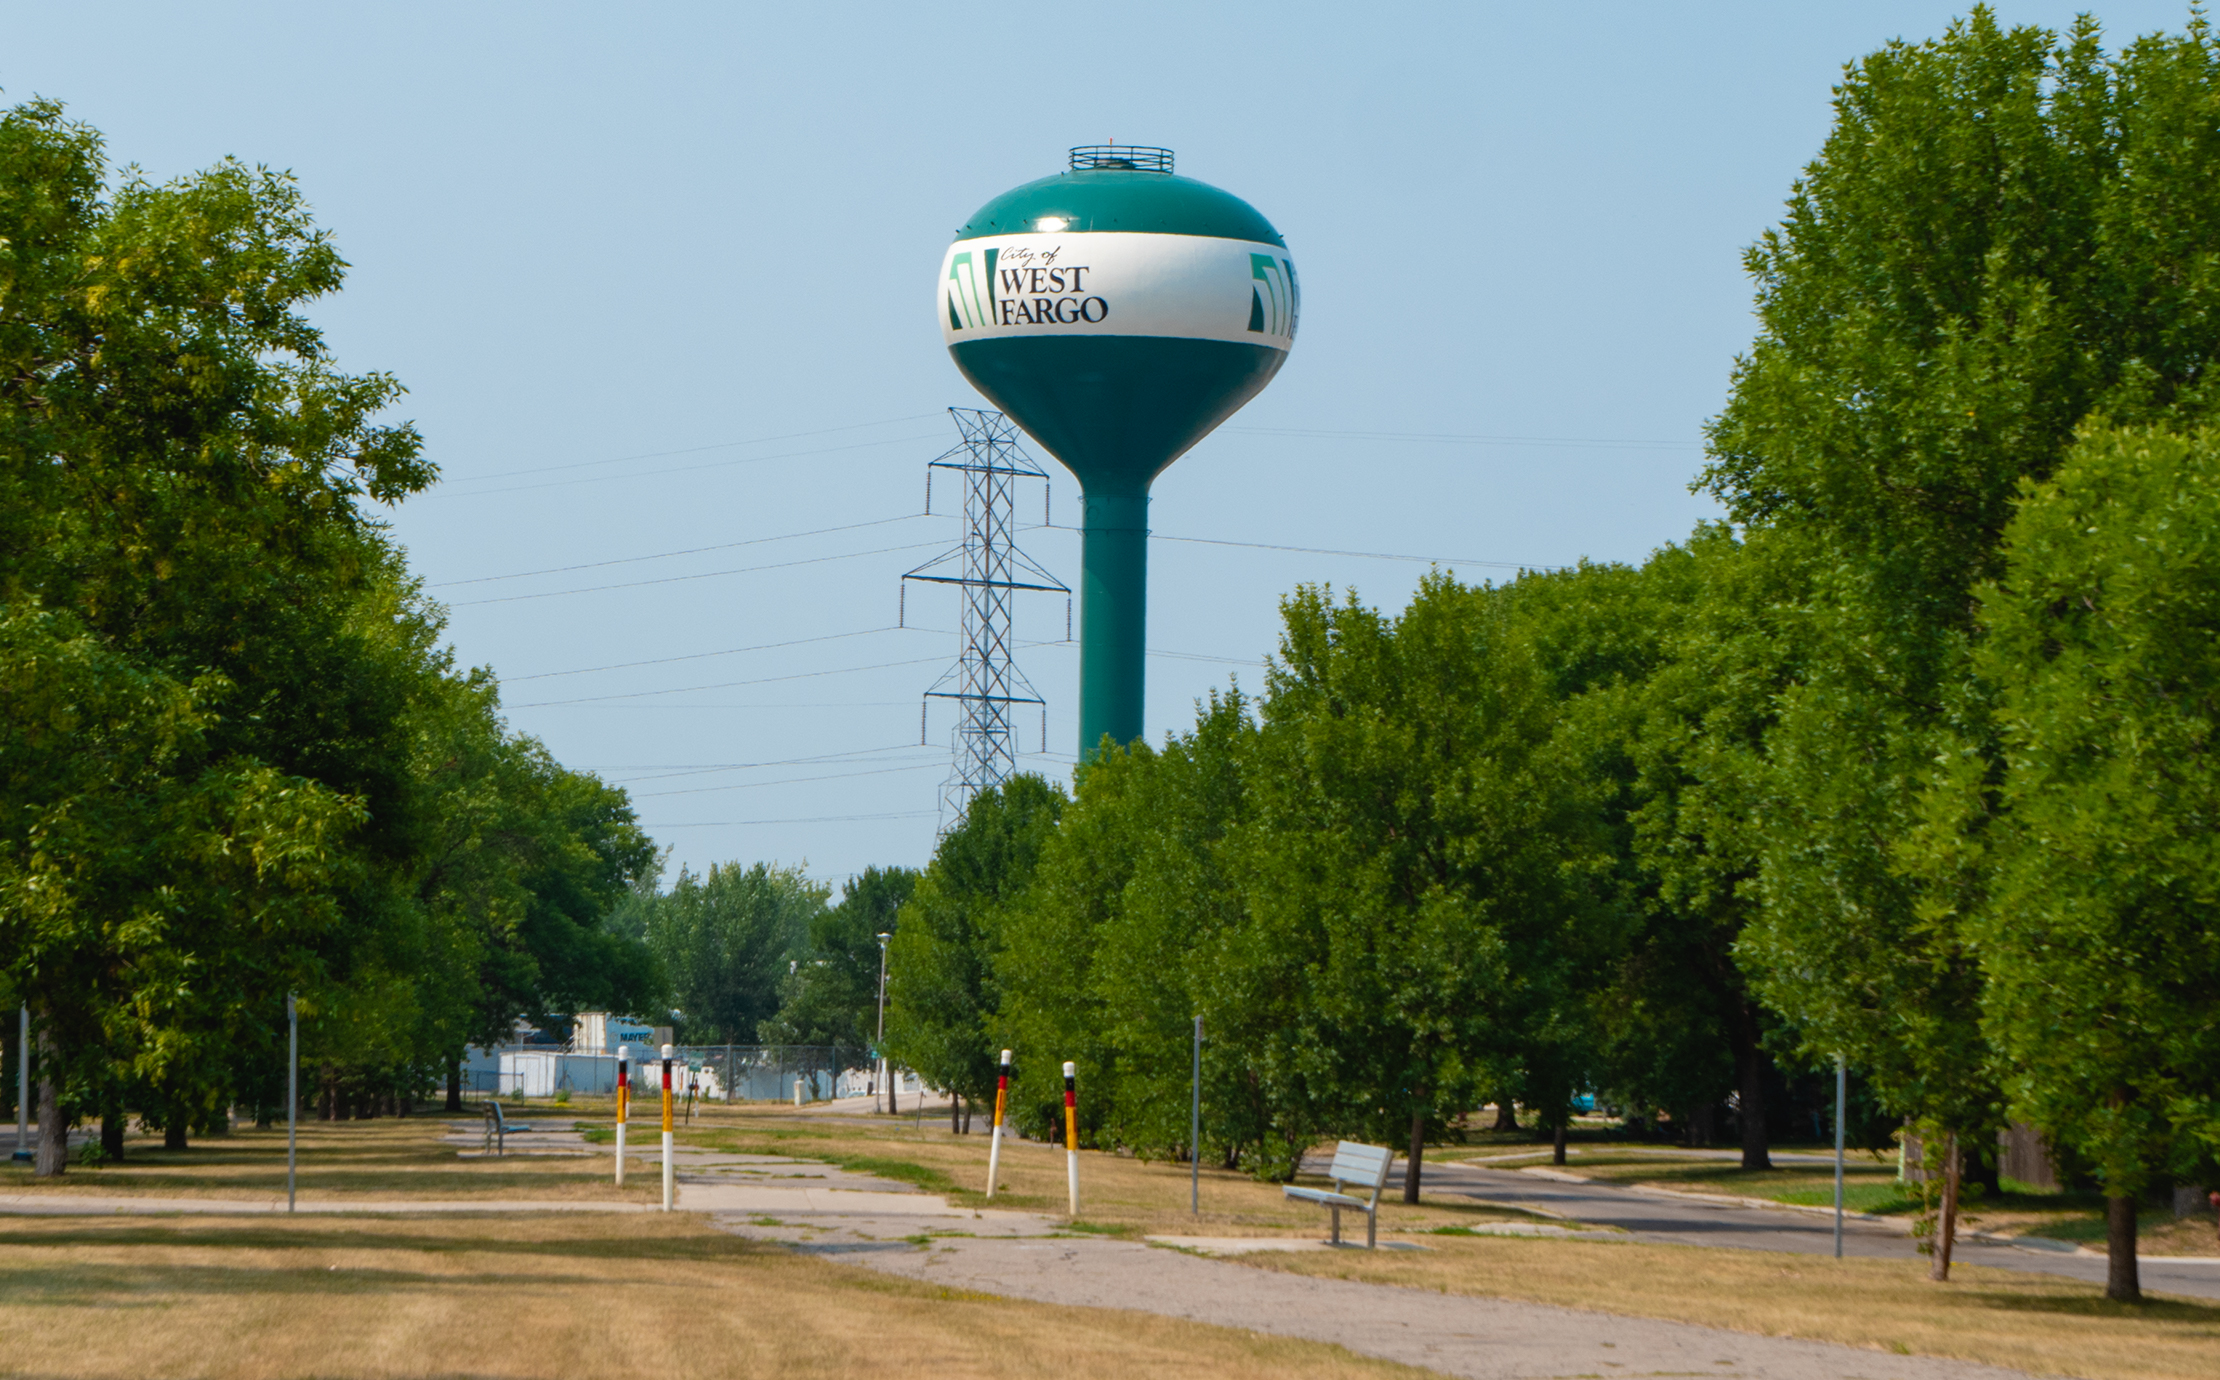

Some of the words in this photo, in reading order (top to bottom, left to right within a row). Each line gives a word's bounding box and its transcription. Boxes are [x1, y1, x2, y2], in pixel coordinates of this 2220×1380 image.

[1001, 246, 1036, 267] City
[1041, 245, 1061, 266] of
[1000, 267, 1090, 294] WEST
[1000, 296, 1109, 325] FARGO
